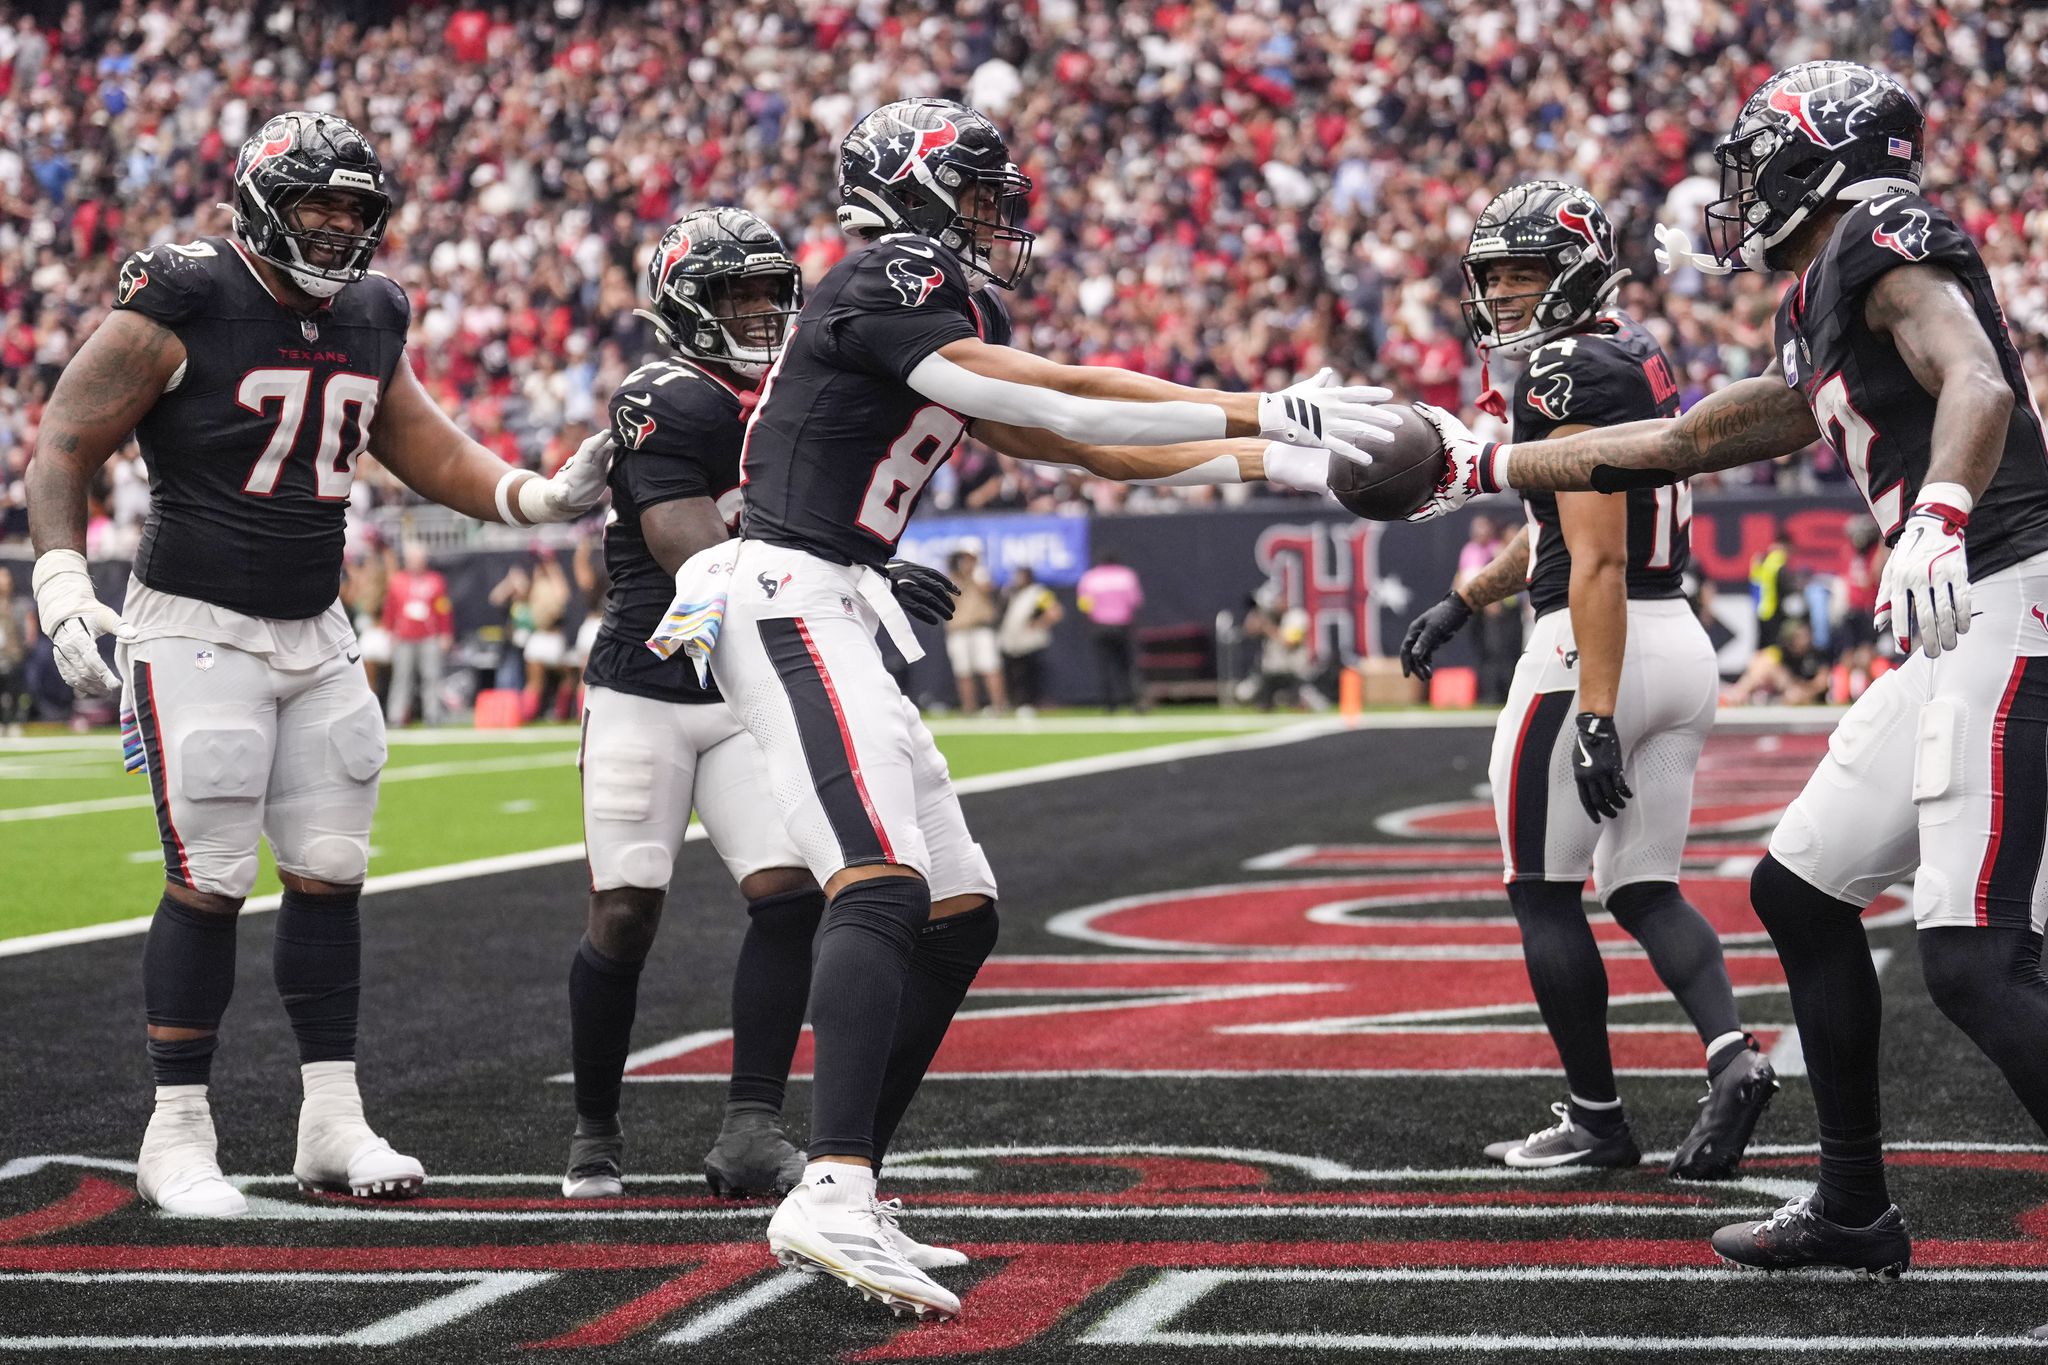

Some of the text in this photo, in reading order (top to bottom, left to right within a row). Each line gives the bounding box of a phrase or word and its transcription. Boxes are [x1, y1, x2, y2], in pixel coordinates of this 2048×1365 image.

[339, 174, 372, 185] TEXANS
[278, 349, 348, 363] TEXANS
[235, 366, 381, 500] 70
[855, 401, 968, 545] 8
